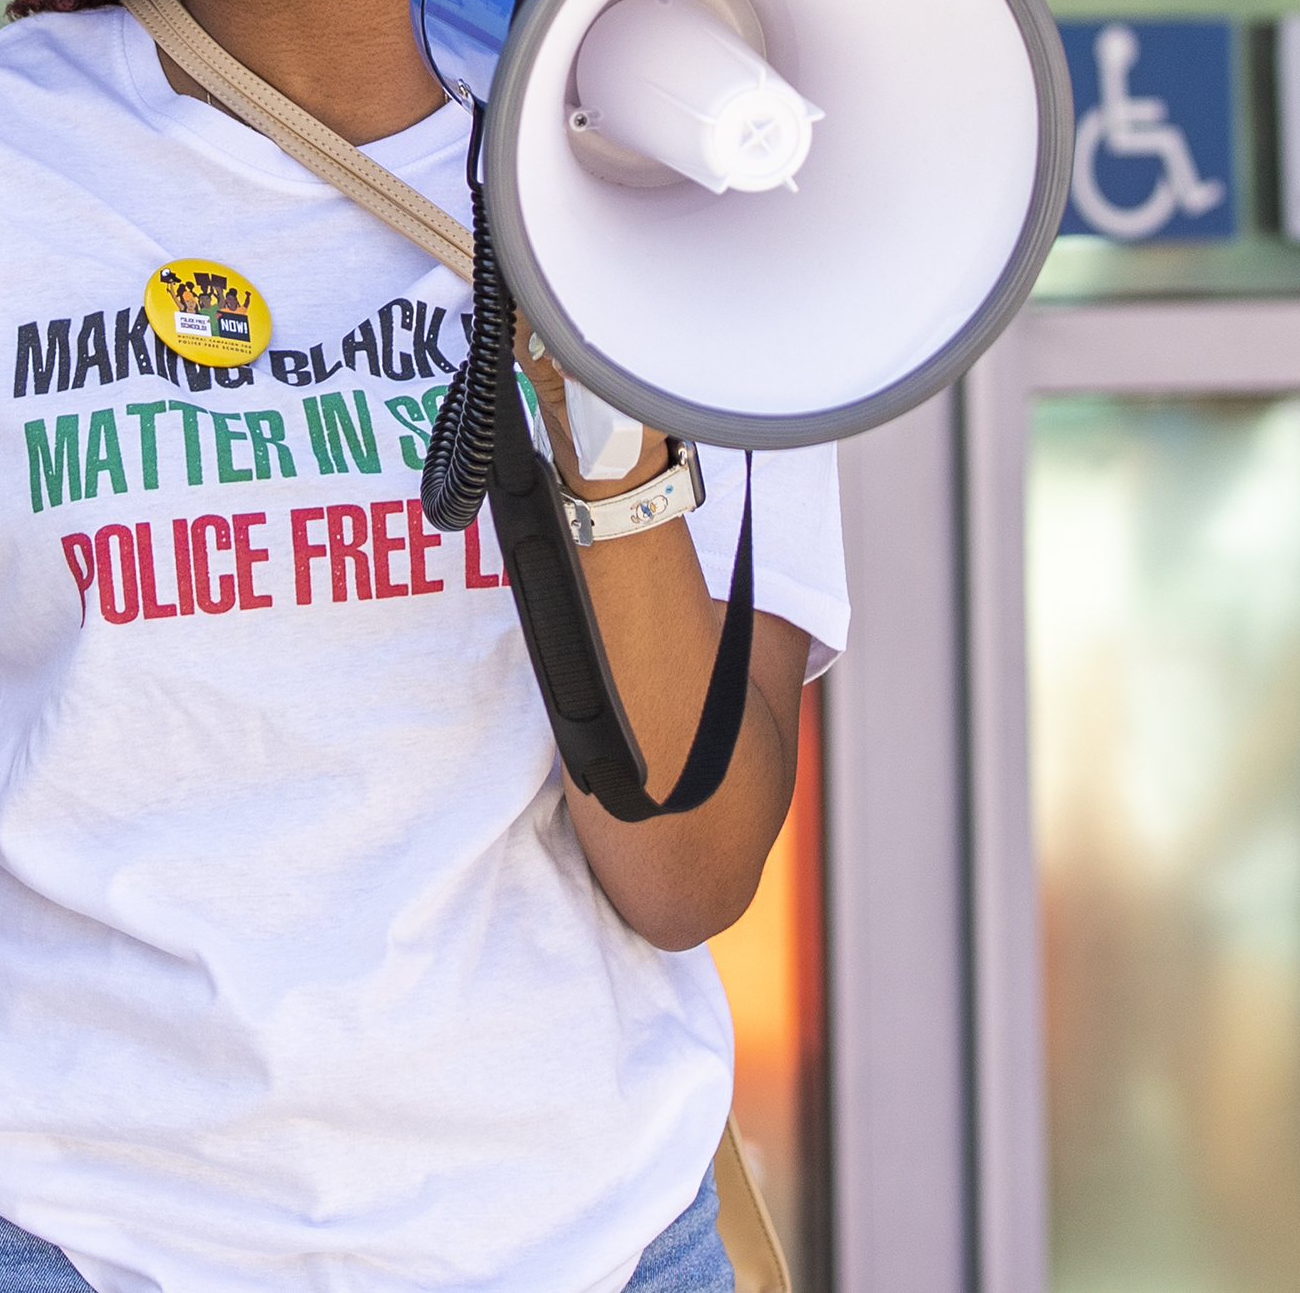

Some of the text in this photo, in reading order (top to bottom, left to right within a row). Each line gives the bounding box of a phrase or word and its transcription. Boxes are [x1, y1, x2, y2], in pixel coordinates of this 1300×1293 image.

[177, 334, 207, 342] NATIONAL
[209, 338, 239, 347] CAMPAIGN
[220, 318, 248, 334] NOW!
[222, 346, 252, 355] SCHOOLS
[269, 298, 460, 387] BLACK
[24, 399, 298, 513] MATTER
[302, 389, 382, 475] IN
[61, 512, 273, 629] POLICE
[290, 497, 445, 606] FREE
